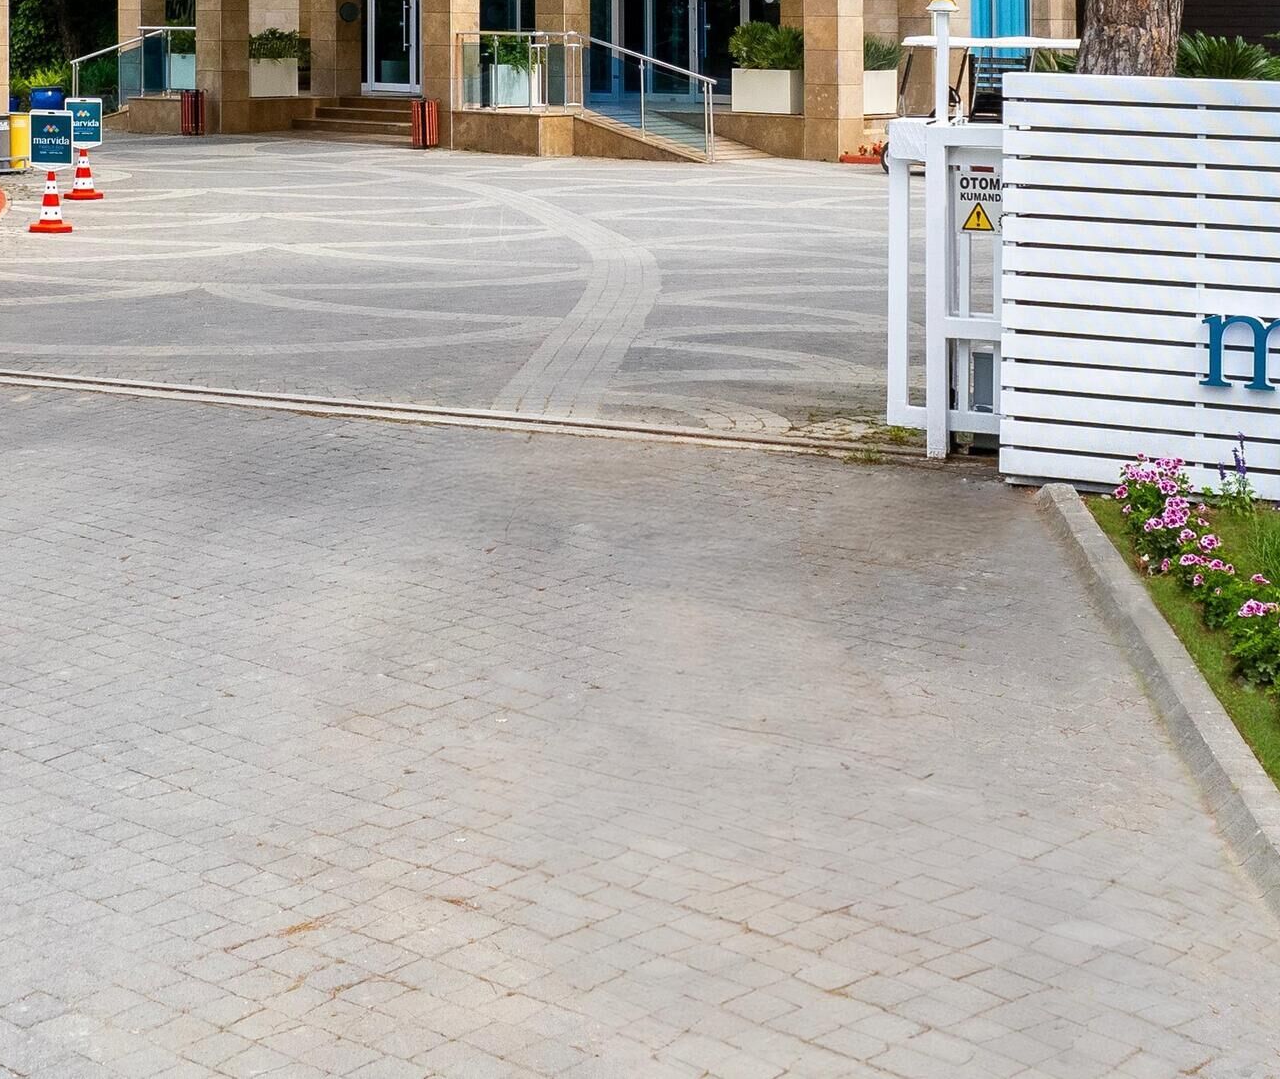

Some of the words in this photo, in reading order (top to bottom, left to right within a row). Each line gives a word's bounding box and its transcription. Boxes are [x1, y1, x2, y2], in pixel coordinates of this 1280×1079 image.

[73, 119, 99, 127] arvida
[33, 136, 70, 145] marvida
[960, 177, 1004, 191] OTOM
[960, 192, 1004, 203] KUMAND
